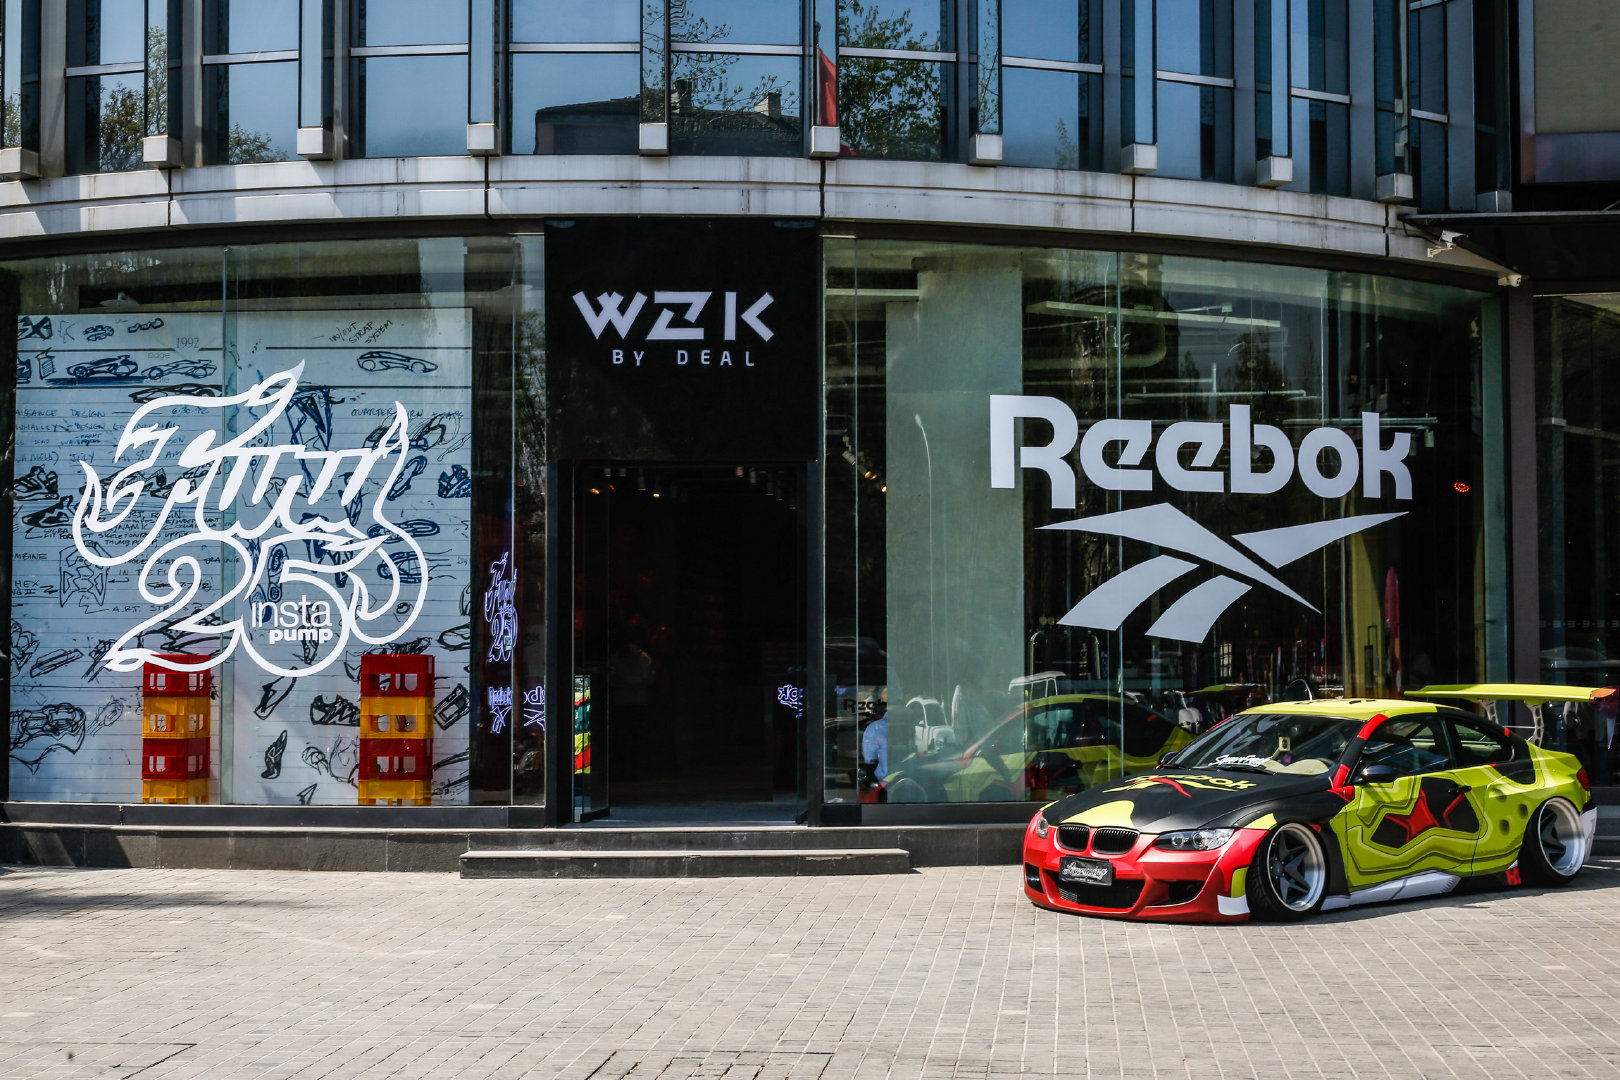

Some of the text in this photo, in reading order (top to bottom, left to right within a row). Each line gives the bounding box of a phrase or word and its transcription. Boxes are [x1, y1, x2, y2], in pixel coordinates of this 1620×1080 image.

[572, 290, 775, 342] WZK
[612, 349, 755, 367] BY DEAL
[990, 394, 1413, 509] Reebok
[251, 595, 333, 628] insta
[268, 628, 334, 645] pump
